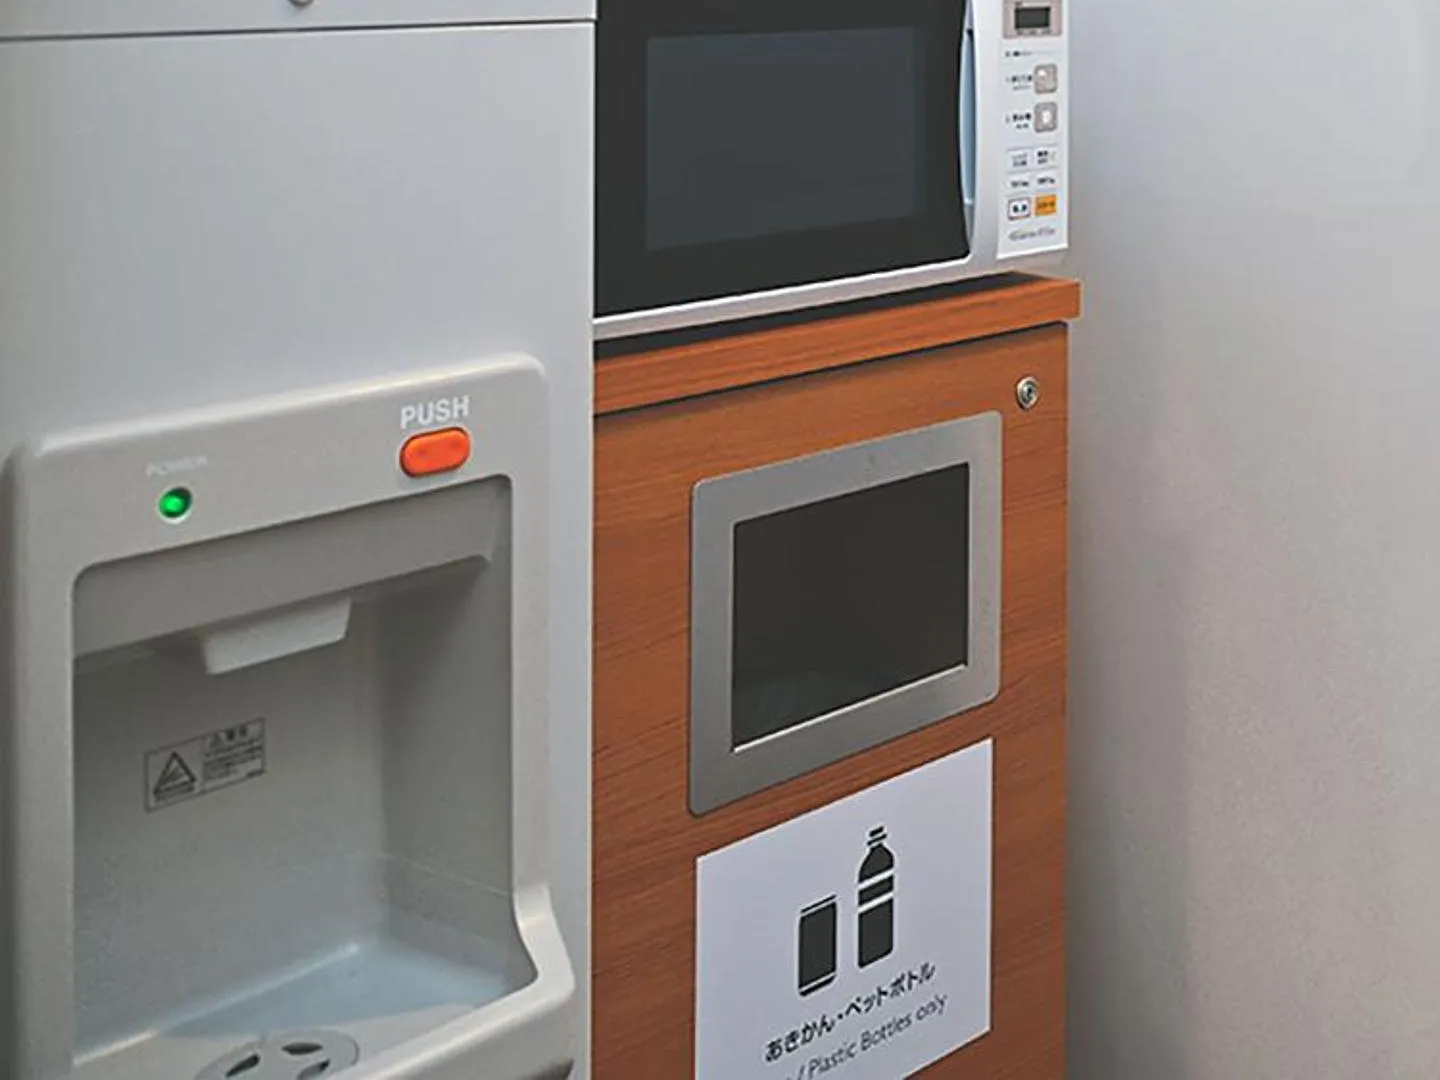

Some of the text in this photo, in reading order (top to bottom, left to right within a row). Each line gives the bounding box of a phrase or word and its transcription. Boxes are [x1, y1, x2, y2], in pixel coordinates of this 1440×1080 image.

[400, 395, 469, 430] PUSH
[765, 962, 936, 1062] あきかん・ペットボトル
[807, 1041, 857, 1080] Plastic
[860, 1013, 913, 1051] Bottles
[916, 993, 948, 1022] only
